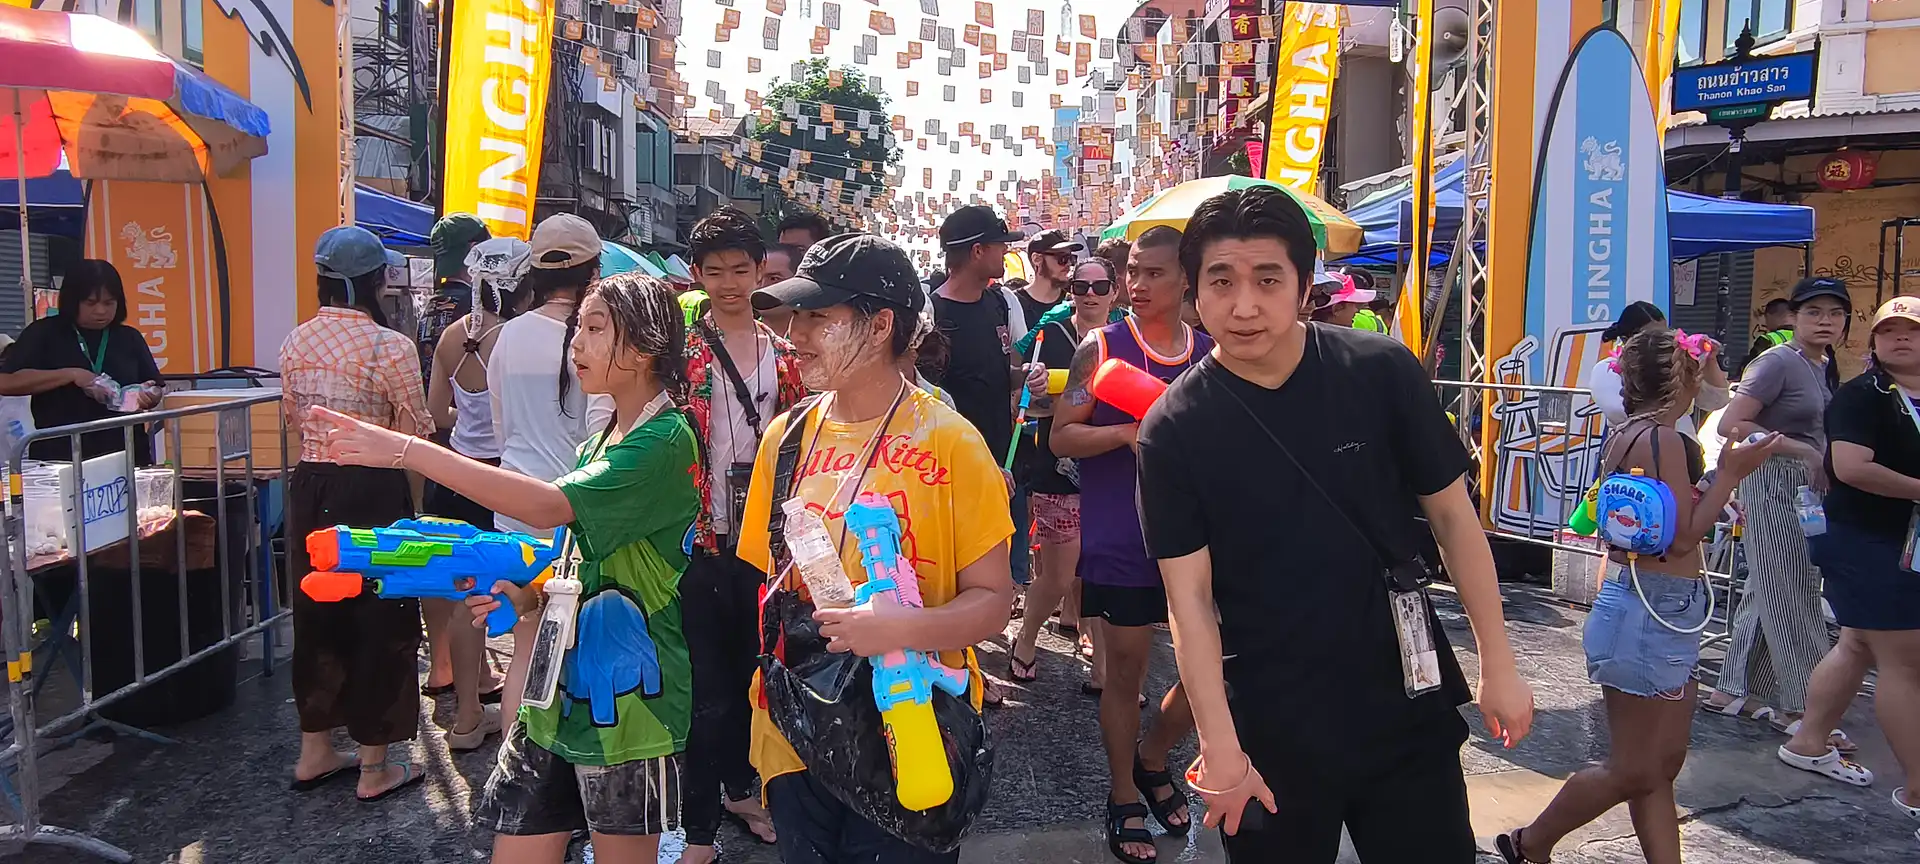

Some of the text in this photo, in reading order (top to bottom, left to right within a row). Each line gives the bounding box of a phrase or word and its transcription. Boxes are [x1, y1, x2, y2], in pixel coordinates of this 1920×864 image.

[1697, 66, 1789, 89] ถนนข้าวสาร
[1697, 83, 1787, 101] Thanon Khao San
[1587, 187, 1613, 322] SINGHA
[1892, 301, 1908, 313] LA
[137, 276, 169, 369] GHA
[793, 434, 952, 486] ello Kitty
[1603, 483, 1645, 503] SHARK
